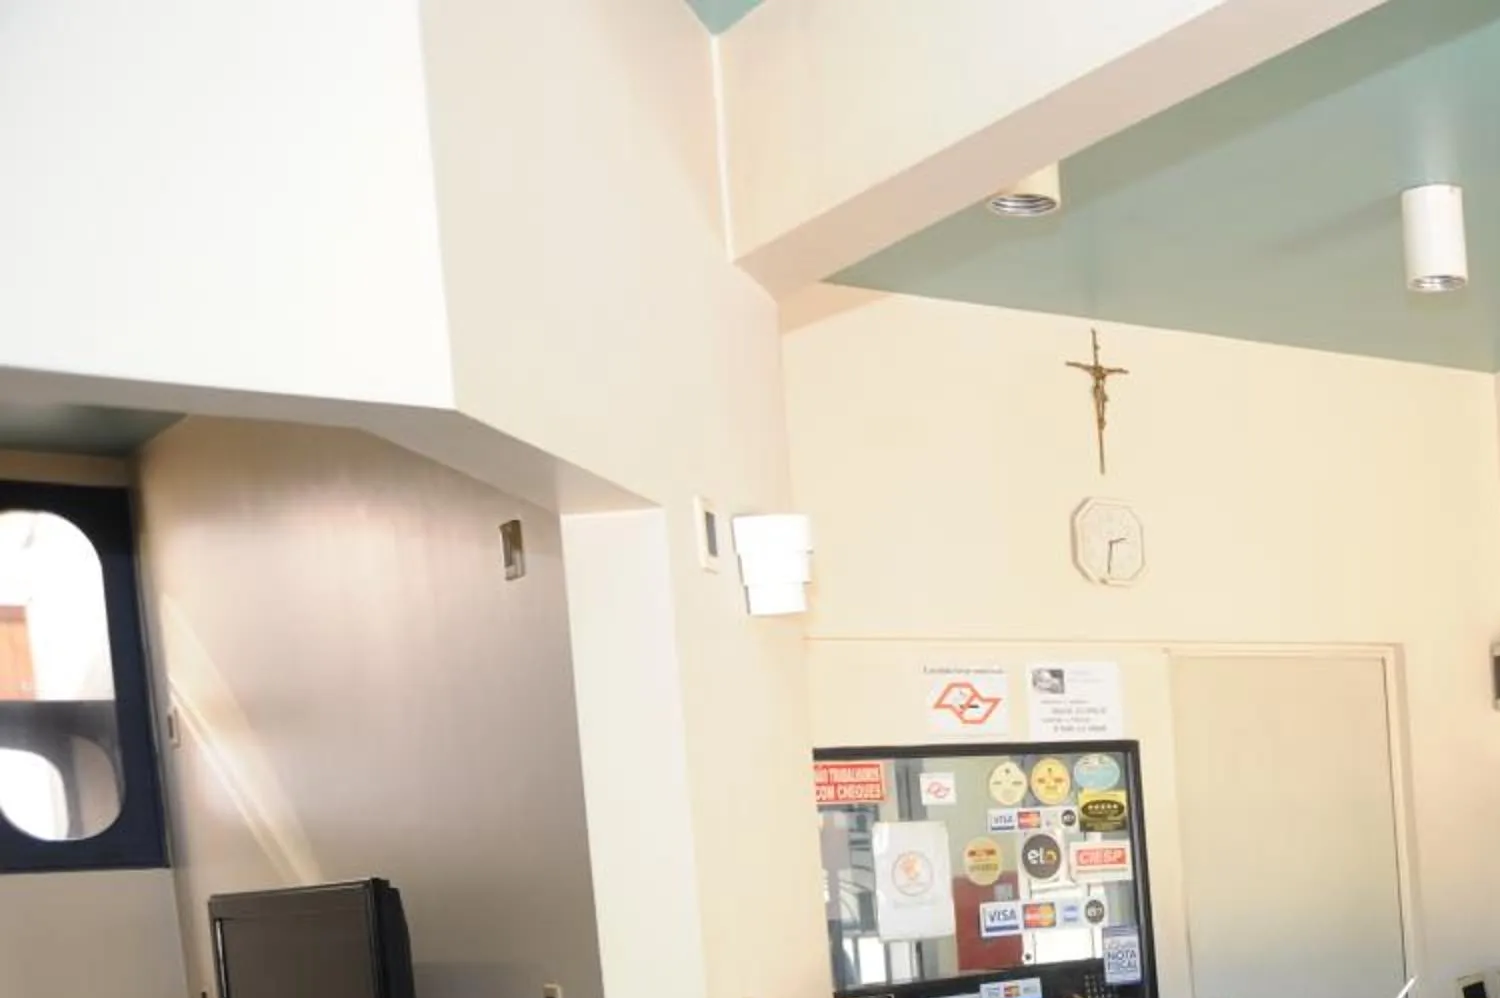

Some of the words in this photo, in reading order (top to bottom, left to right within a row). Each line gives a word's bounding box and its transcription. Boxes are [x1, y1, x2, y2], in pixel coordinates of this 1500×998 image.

[1027, 847, 1057, 865] elo
[989, 909, 1017, 922] VISA
[1107, 950, 1137, 962] NOTA
